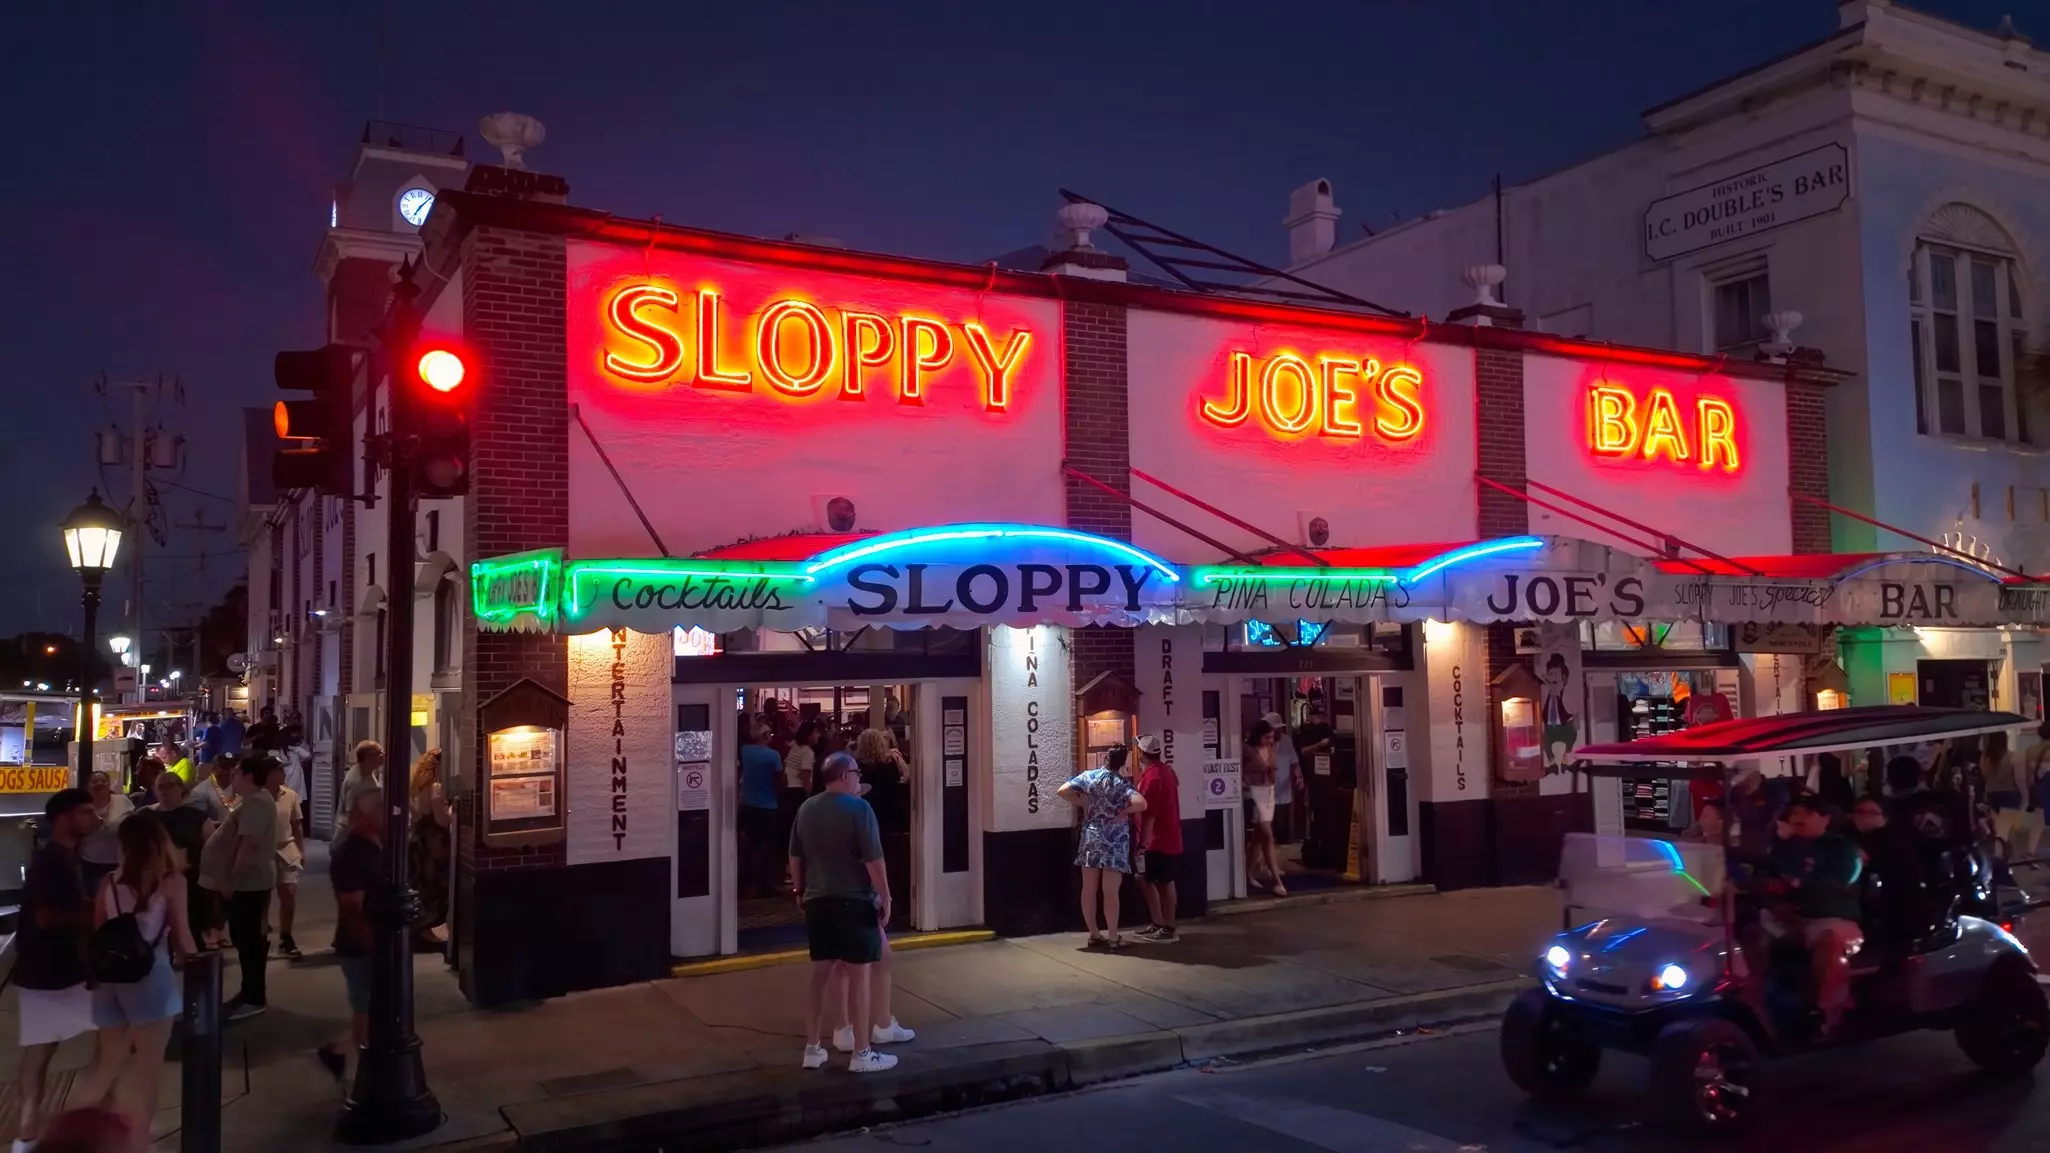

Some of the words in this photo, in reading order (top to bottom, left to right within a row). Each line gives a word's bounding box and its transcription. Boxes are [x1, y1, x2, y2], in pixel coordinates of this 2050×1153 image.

[1684, 183, 1784, 230] DOUBLE'S
[1795, 163, 1844, 195] BAR
[1712, 171, 1769, 198] HISTORIC
[1710, 220, 1744, 240] BUILT
[603, 283, 1033, 414] SLOPPY
[1199, 350, 1424, 441] JOE'S
[1589, 385, 1740, 469] BAR
[612, 575, 795, 611] Cocktails
[846, 562, 1157, 616] SLOPPY
[1487, 574, 1645, 617] JOE'S
[1880, 583, 1958, 619] BAR
[1026, 628, 1039, 688] IÑA
[1162, 638, 1174, 716] DRAFT
[611, 626, 627, 851] NTERTAINMENT
[1163, 729, 1175, 766] BE
[1452, 665, 1467, 791] COCKTAILS
[1026, 701, 1040, 814] COLADAS
